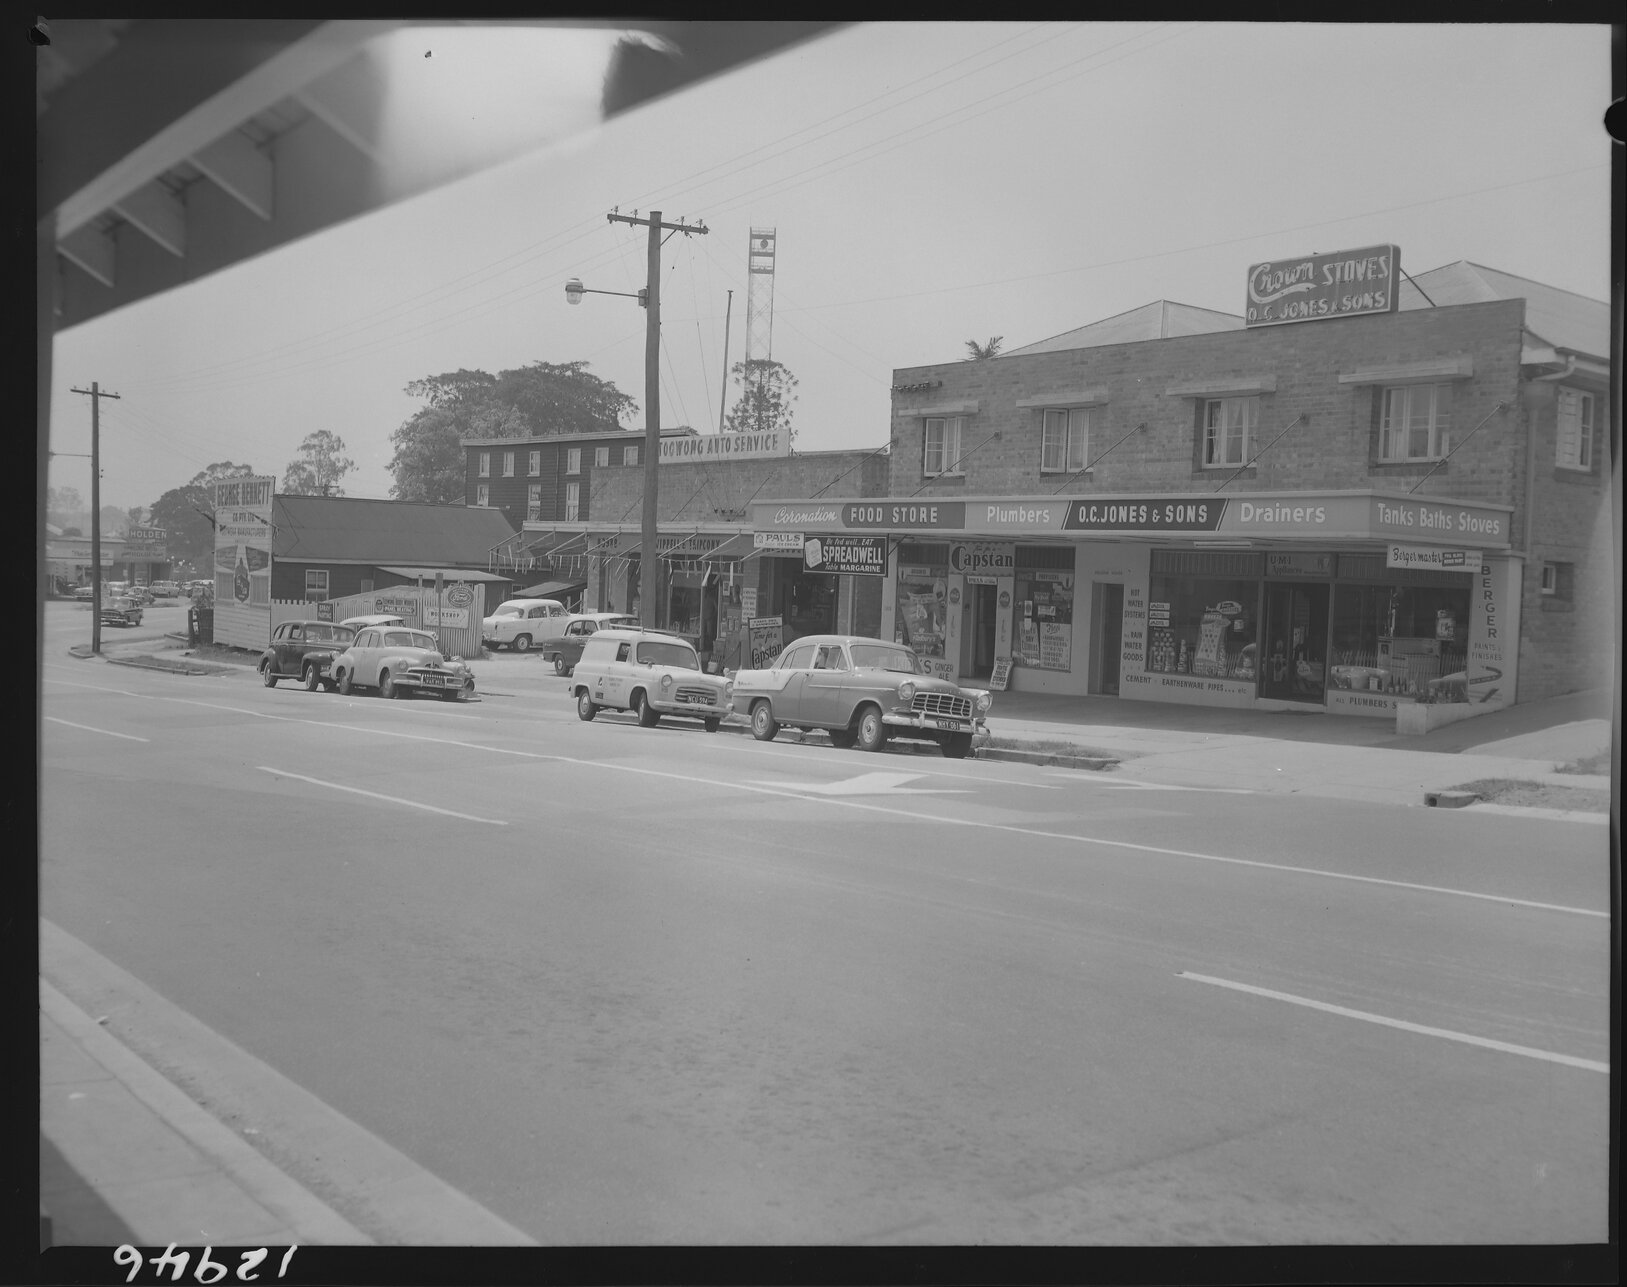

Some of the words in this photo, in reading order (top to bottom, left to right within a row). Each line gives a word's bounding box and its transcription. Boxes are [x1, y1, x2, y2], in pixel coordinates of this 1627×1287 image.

[1250, 263, 1317, 304] Crown
[1322, 255, 1389, 286] STOVES
[1279, 298, 1328, 319] JONES
[1342, 290, 1385, 311] SONS
[707, 436, 731, 454] AUTO
[734, 433, 778, 452] SERVICE
[774, 506, 838, 524] Coronation
[850, 506, 883, 523] FOOD
[892, 506, 938, 523] STORE
[986, 505, 1050, 523] Plumbers
[1152, 508, 1161, 524] &
[1165, 504, 1208, 524] SONS
[1240, 502, 1326, 524] Drainers
[1377, 502, 1414, 527] Tanks
[1419, 507, 1452, 530] Baths
[1458, 514, 1500, 535] Stoves
[130, 530, 167, 539] HOLDEN
[766, 534, 801, 542] PAULS
[861, 538, 874, 547] EAT
[822, 546, 884, 565] SPREADWELL
[951, 546, 1013, 572] Capstan
[824, 562, 838, 571] Table
[839, 563, 881, 573] MARGARINE
[452, 593, 468, 601] Ford
[1130, 589, 1140, 597] HOT
[1127, 599, 1144, 608] WATER
[1481, 565, 1498, 639] BERGER
[1124, 610, 1146, 619] SYSTEMS
[1130, 631, 1143, 639] RAIN
[1124, 641, 1143, 650] WATER
[1474, 642, 1496, 651] PAINTS
[752, 643, 783, 671] Capstan
[1122, 653, 1144, 661] GOODS
[1471, 653, 1503, 661] FINISHES
[935, 664, 954, 675] GINGER
[939, 673, 949, 681] ALE
[1125, 674, 1152, 684] CEMENT
[1162, 678, 1204, 690] EARTHENWARE
[1349, 696, 1388, 708] PLUMBERS
